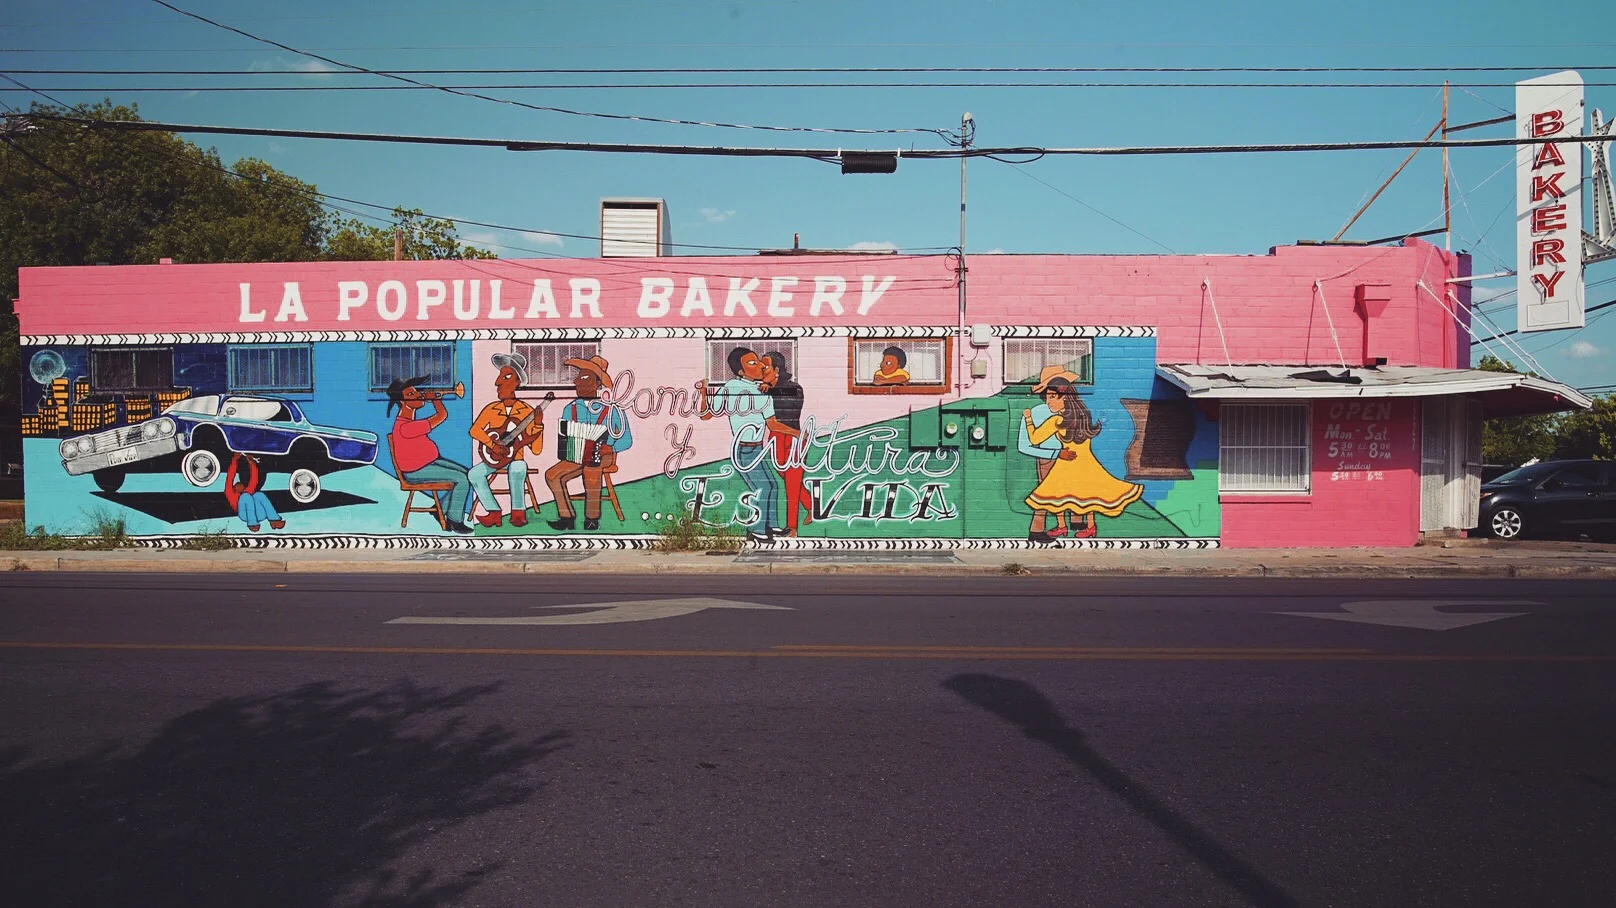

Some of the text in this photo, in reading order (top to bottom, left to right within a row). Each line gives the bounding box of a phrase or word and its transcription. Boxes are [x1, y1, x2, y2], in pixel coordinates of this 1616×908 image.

[1532, 109, 1567, 298] BAKERY
[239, 275, 897, 322] LA POPULAR BAKERY
[1329, 402, 1392, 420] OPEN
[731, 413, 960, 478] Cultura
[1337, 461, 1371, 471] Sunday
[804, 474, 959, 526] VIDA
